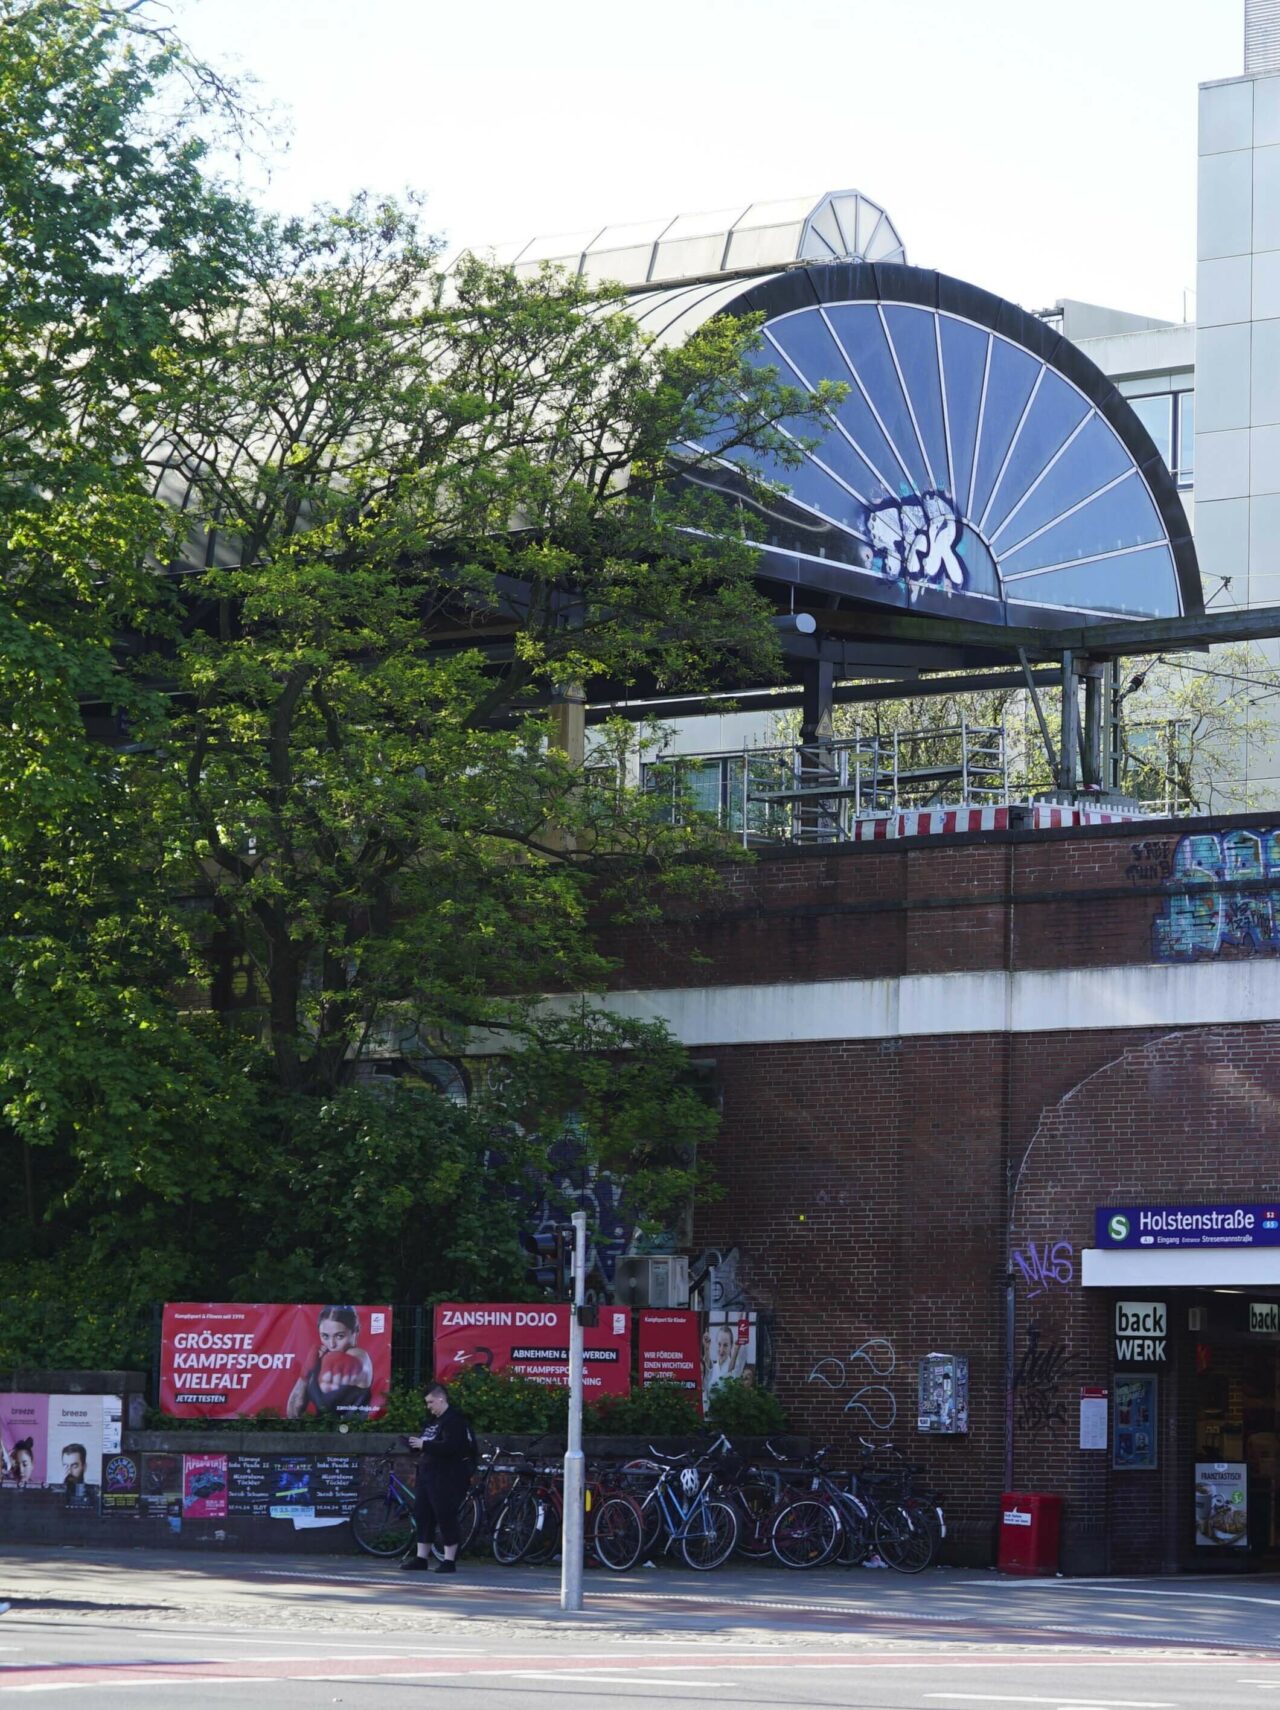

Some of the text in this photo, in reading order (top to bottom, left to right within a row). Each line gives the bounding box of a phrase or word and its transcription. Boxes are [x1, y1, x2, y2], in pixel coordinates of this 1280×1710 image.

[1140, 1209, 1254, 1231] Holstenstraße
[1157, 1235, 1180, 1245] Eingang
[1201, 1234, 1253, 1245] Stresemannstraße
[442, 1311, 557, 1327] ZANSHIN DOJO
[1117, 1304, 1164, 1333] back
[1250, 1305, 1277, 1331] back
[174, 1331, 254, 1349] GRÖSSTE
[512, 1350, 560, 1359] ABNEHMEN
[560, 1351, 567, 1359] &
[643, 1350, 683, 1359] WIR FÖRDERN
[1115, 1339, 1167, 1361] WERK
[173, 1353, 295, 1369] KAMPFSPORT
[643, 1361, 661, 1369] EINEN
[526, 1365, 569, 1375] KAMPFSPO
[173, 1373, 252, 1389] VIELFALT
[175, 1394, 226, 1403] JETZT TESTEN
[62, 1408, 87, 1417] breeze
[1200, 1471, 1242, 1481] FRANZTASTISCH
